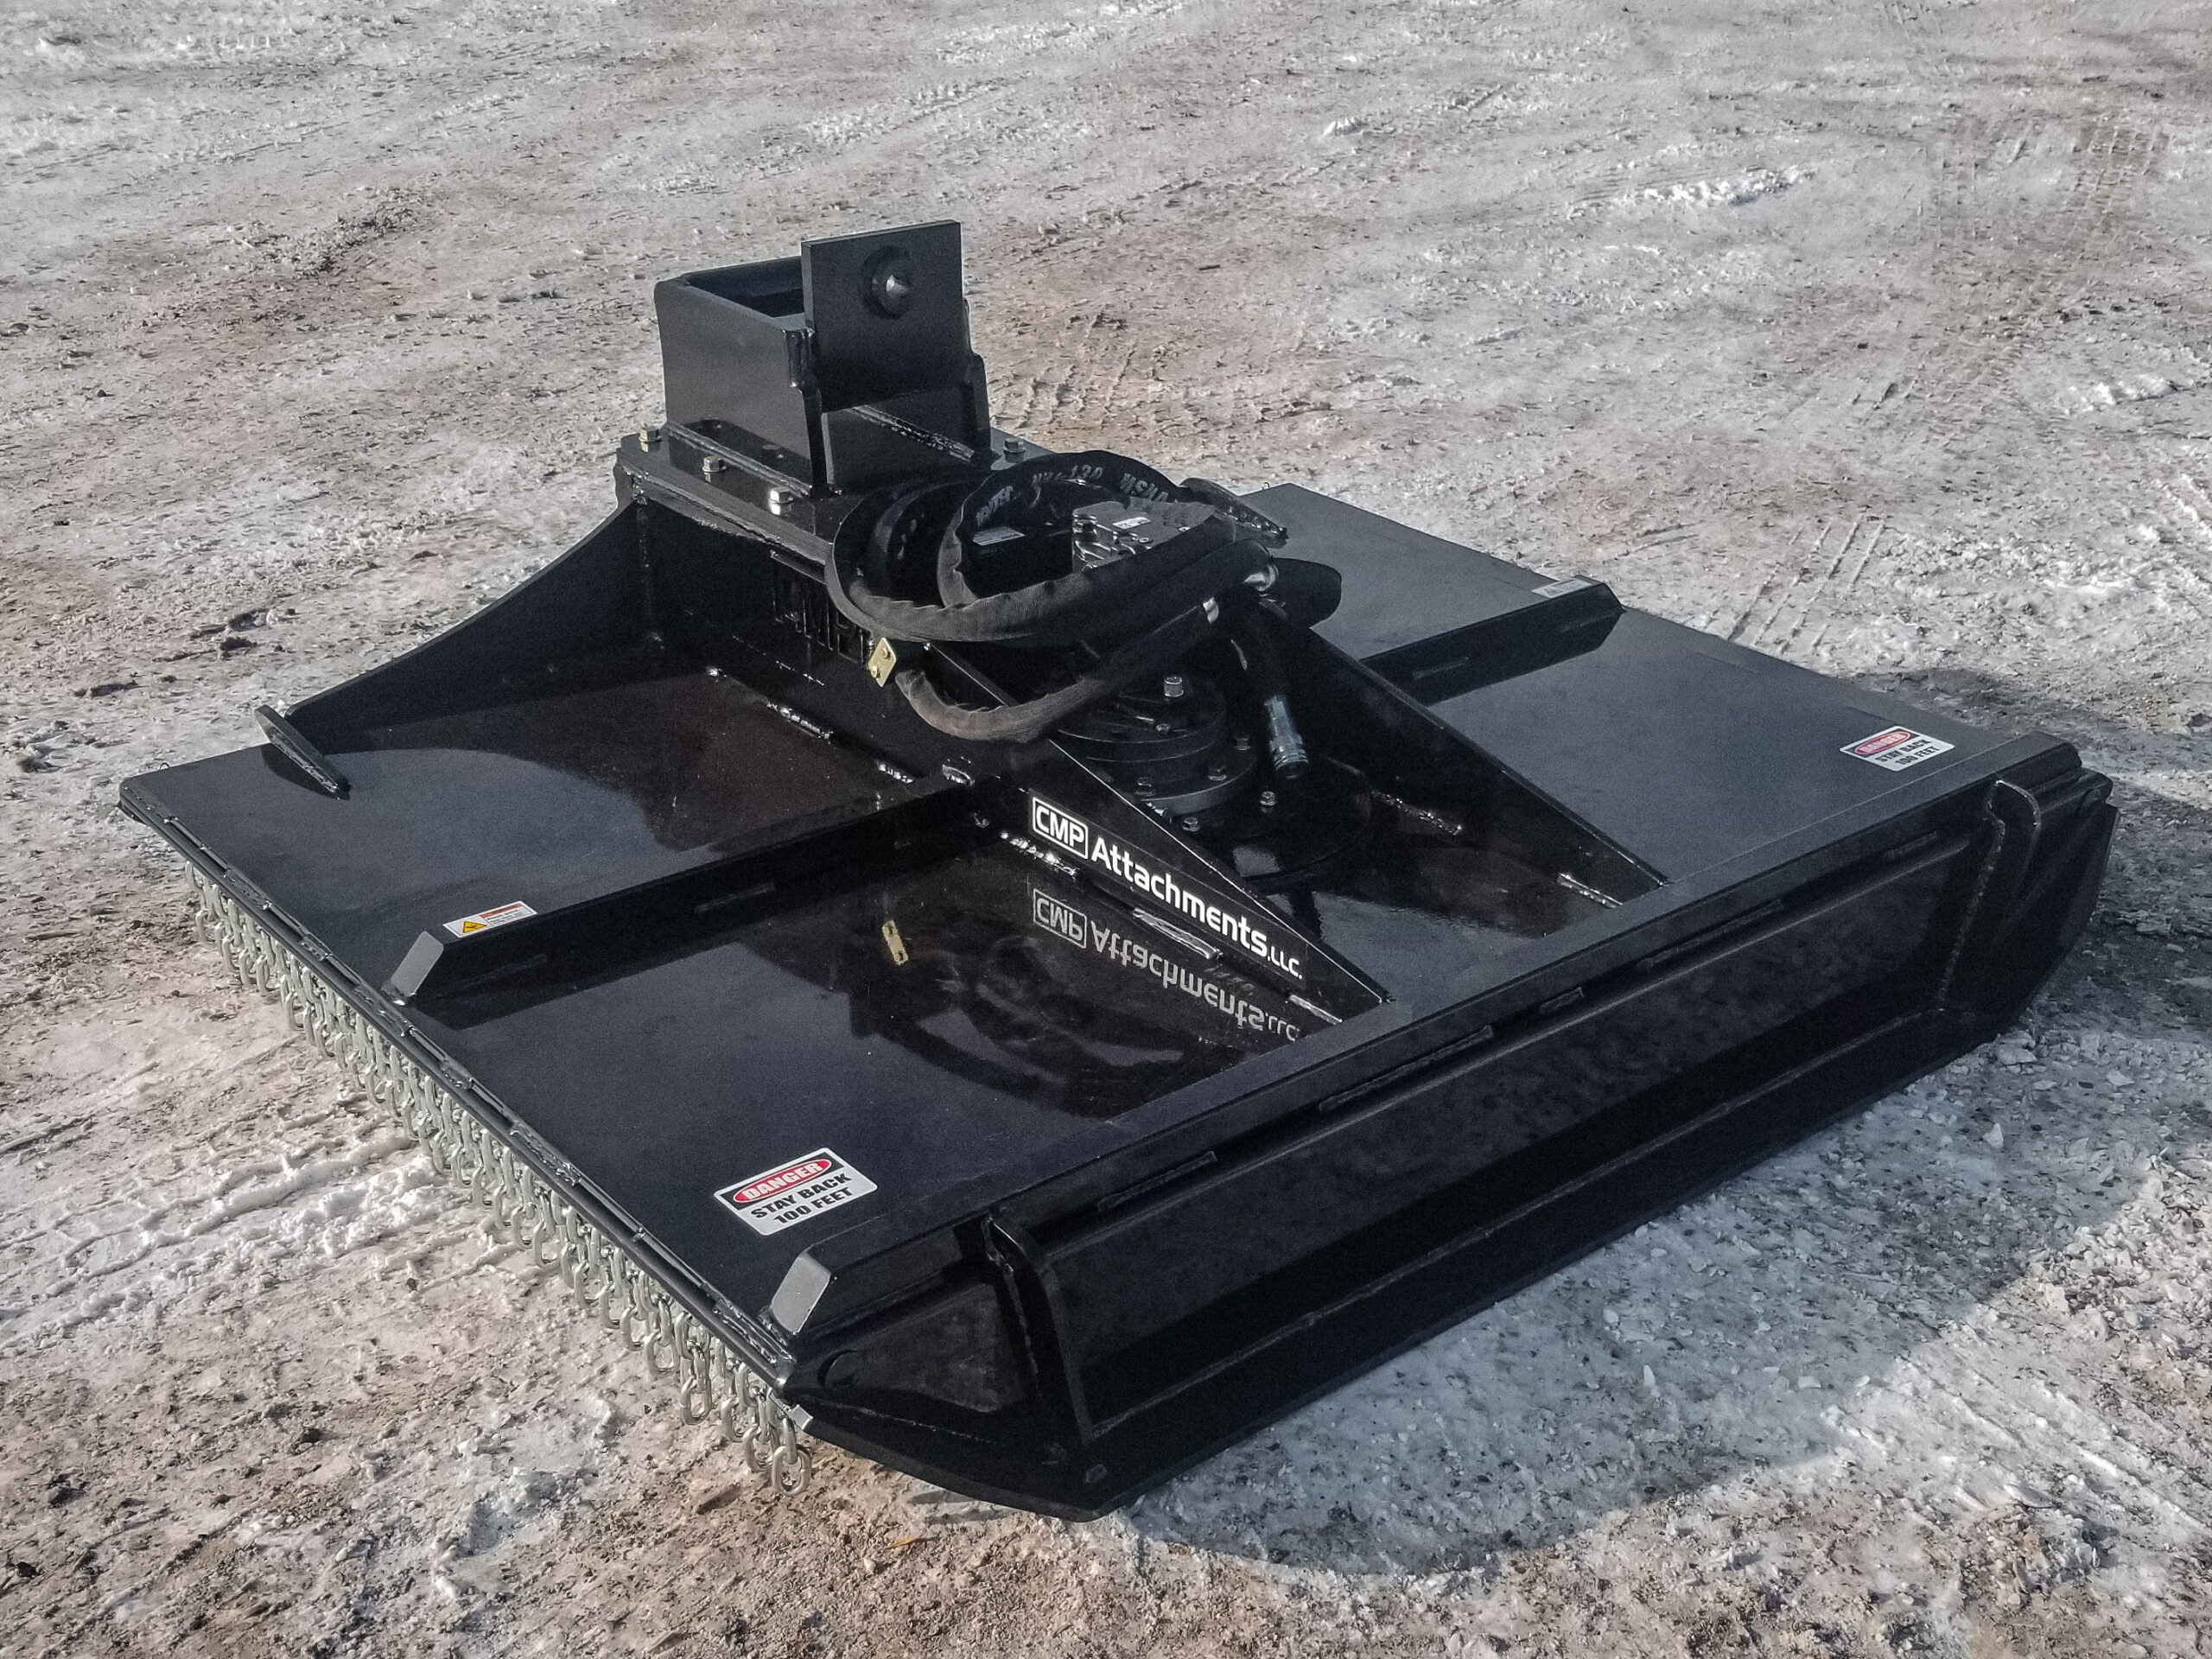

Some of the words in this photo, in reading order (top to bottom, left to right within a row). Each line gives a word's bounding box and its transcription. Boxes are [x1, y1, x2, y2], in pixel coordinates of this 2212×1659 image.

[1862, 733, 1906, 753] DANGER
[1874, 748, 1904, 762] STAY
[1902, 739, 1932, 753] BACK
[1895, 754, 1918, 766] 100
[1916, 746, 1942, 758] FEET
[1036, 804, 1085, 848] CMP
[741, 1161, 822, 1200] DANGER
[751, 1195, 798, 1218] STAY
[798, 1173, 852, 1199] BACK
[773, 1206, 812, 1224] 100
[811, 1186, 854, 1210] FEET
